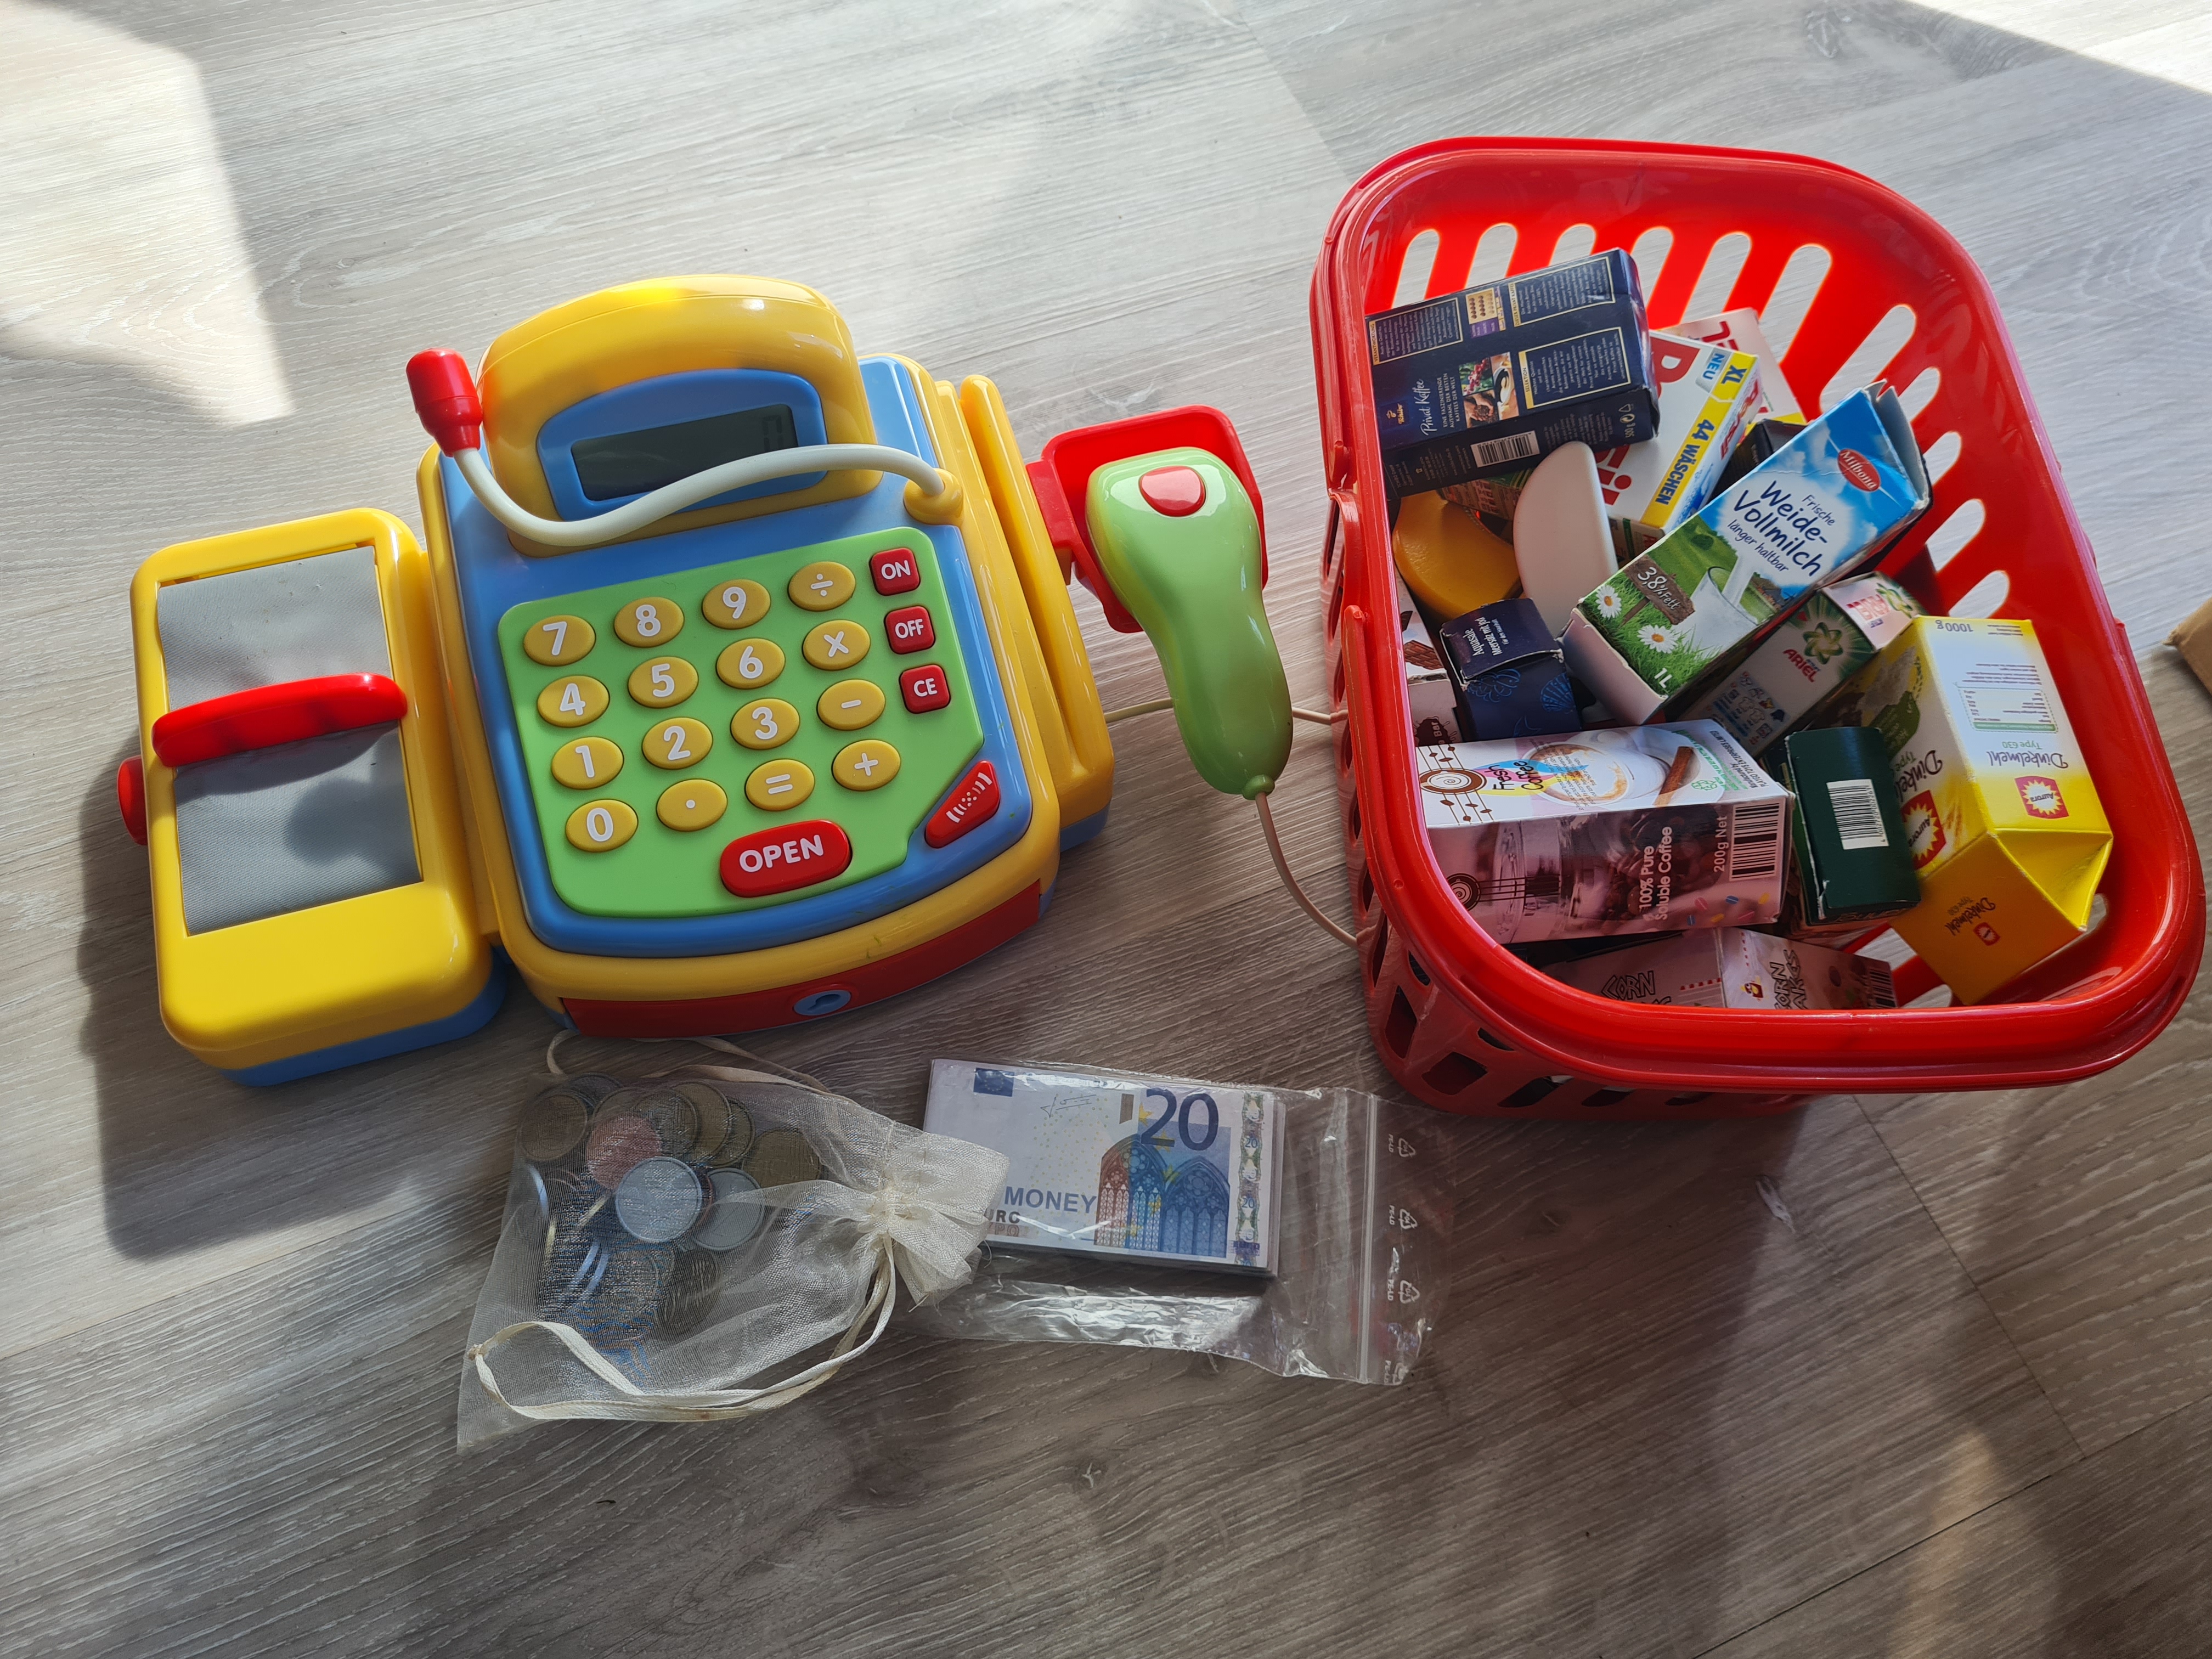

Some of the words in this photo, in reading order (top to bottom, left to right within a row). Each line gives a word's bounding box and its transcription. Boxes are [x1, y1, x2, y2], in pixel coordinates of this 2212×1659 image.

[1370, 323, 1379, 362] VERANTWORTUNG
[1701, 350, 1725, 382] NEU
[1720, 361, 1747, 391] XL
[1410, 377, 1432, 406] Kaffee
[1436, 376, 1446, 415] FASZINIERENDE
[1395, 402, 1406, 425] Tchibo
[1416, 405, 1438, 436] Privat
[1446, 403, 1455, 428] AUSWAHL
[1452, 400, 1461, 422] KAFFEES
[1623, 427, 1635, 438] 500
[1691, 417, 1716, 444] 44
[1654, 443, 1701, 506] WÄSCHEN
[1838, 447, 1877, 492] Milbona
[1762, 480, 1827, 545] Weide-
[1801, 493, 1837, 527] Frische
[1727, 518, 1758, 546] länger
[1753, 541, 1789, 575] haltbar
[1733, 489, 1822, 578] Vollmilch
[881, 560, 911, 578] ON
[723, 587, 747, 619] 9
[636, 605, 659, 637] 8
[894, 620, 924, 638] OFF
[1479, 624, 1492, 634] mit
[1934, 619, 1944, 630] g
[1944, 622, 1973, 632] 1000
[542, 621, 567, 656] 7
[1462, 627, 1485, 656] Aquasale
[1483, 633, 1503, 655] Meersalz
[739, 646, 764, 679] 6
[1782, 650, 1818, 682] ARIEL
[652, 665, 674, 698] 5
[913, 679, 936, 697] CE
[560, 684, 586, 716] 4
[752, 707, 778, 740] 3
[664, 727, 691, 760] 2
[1720, 742, 1746, 764] ENTERPRISES
[1986, 750, 2068, 767] Dinkelmehl
[2019, 740, 2042, 749] Type
[575, 746, 595, 778] 1
[1485, 765, 1514, 790] Fresh
[1514, 761, 1544, 791] Coffee
[1740, 763, 1754, 774] TOYS
[1893, 750, 1943, 803] Dinkel
[1750, 773, 1769, 787] PLAYGO
[2029, 792, 2053, 802] Aurora
[586, 808, 613, 842] 0
[1715, 815, 1728, 838] Net
[1906, 815, 1929, 848] Aurora
[740, 836, 824, 872] OPEN
[1641, 845, 1655, 876] Pure
[1657, 826, 1673, 873] Coffee
[1713, 840, 1729, 872] 200g
[1638, 877, 1654, 910] 100%
[1655, 875, 1671, 921] Soluble
[1601, 969, 1655, 1000] CORN
[1141, 1087, 1219, 1151] 20
[1245, 1137, 1258, 1148] 20
[1004, 1186, 1097, 1214] MONEY
[1242, 1198, 1255, 1208] 20
[987, 1209, 1021, 1224] URO
